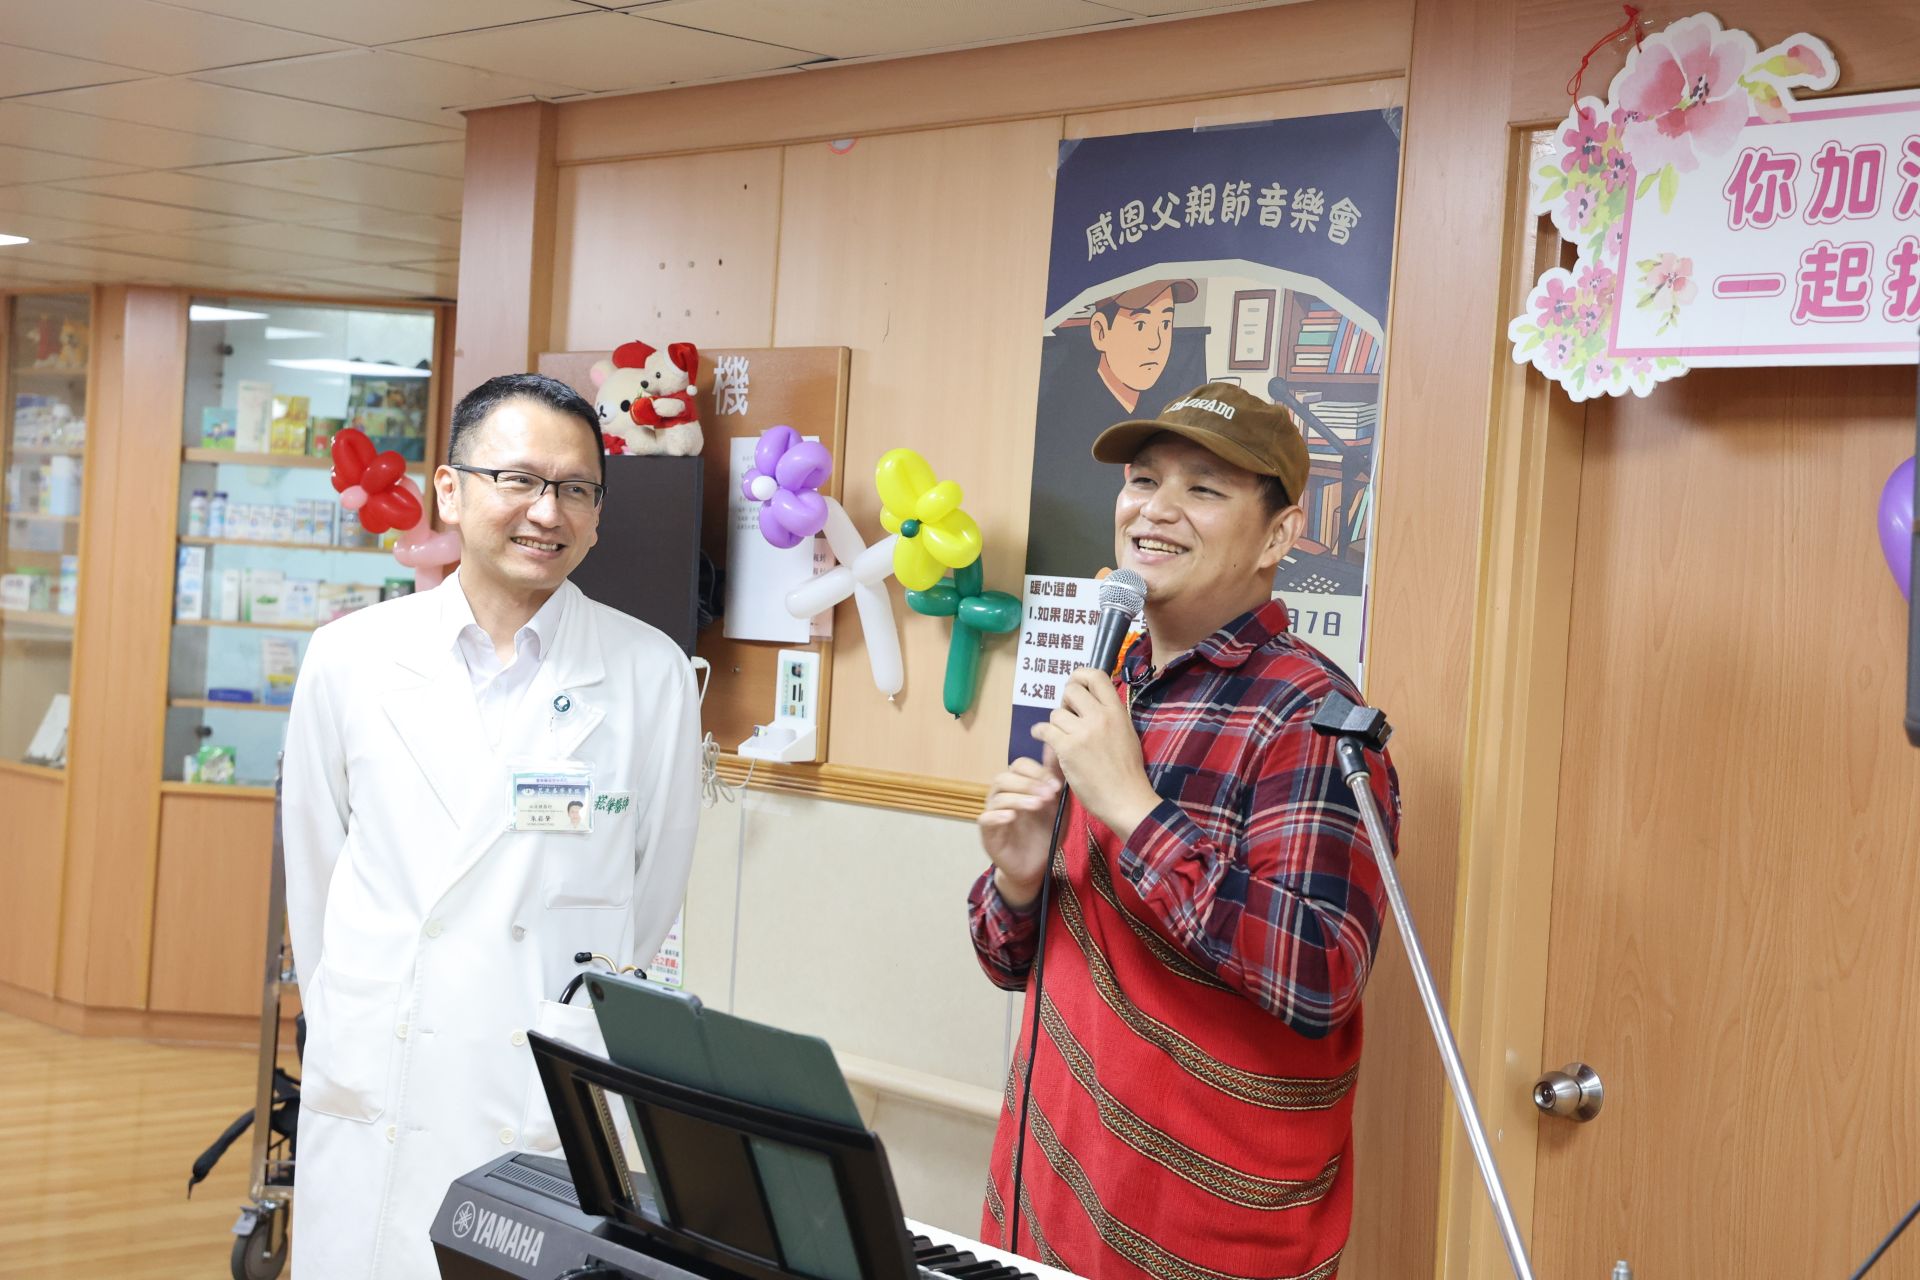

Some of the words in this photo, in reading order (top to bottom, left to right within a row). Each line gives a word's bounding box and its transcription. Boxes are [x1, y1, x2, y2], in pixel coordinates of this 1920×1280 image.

[1087, 180, 1362, 261] 感恩父親節音樂會
[712, 356, 750, 416] 機
[1164, 396, 1235, 420] OLORADO
[1029, 579, 1078, 598] 暖心選曲
[1025, 631, 1085, 652] 2.愛與希望
[1020, 682, 1056, 701] 4.父親
[472, 1208, 546, 1267] YAMAHA
